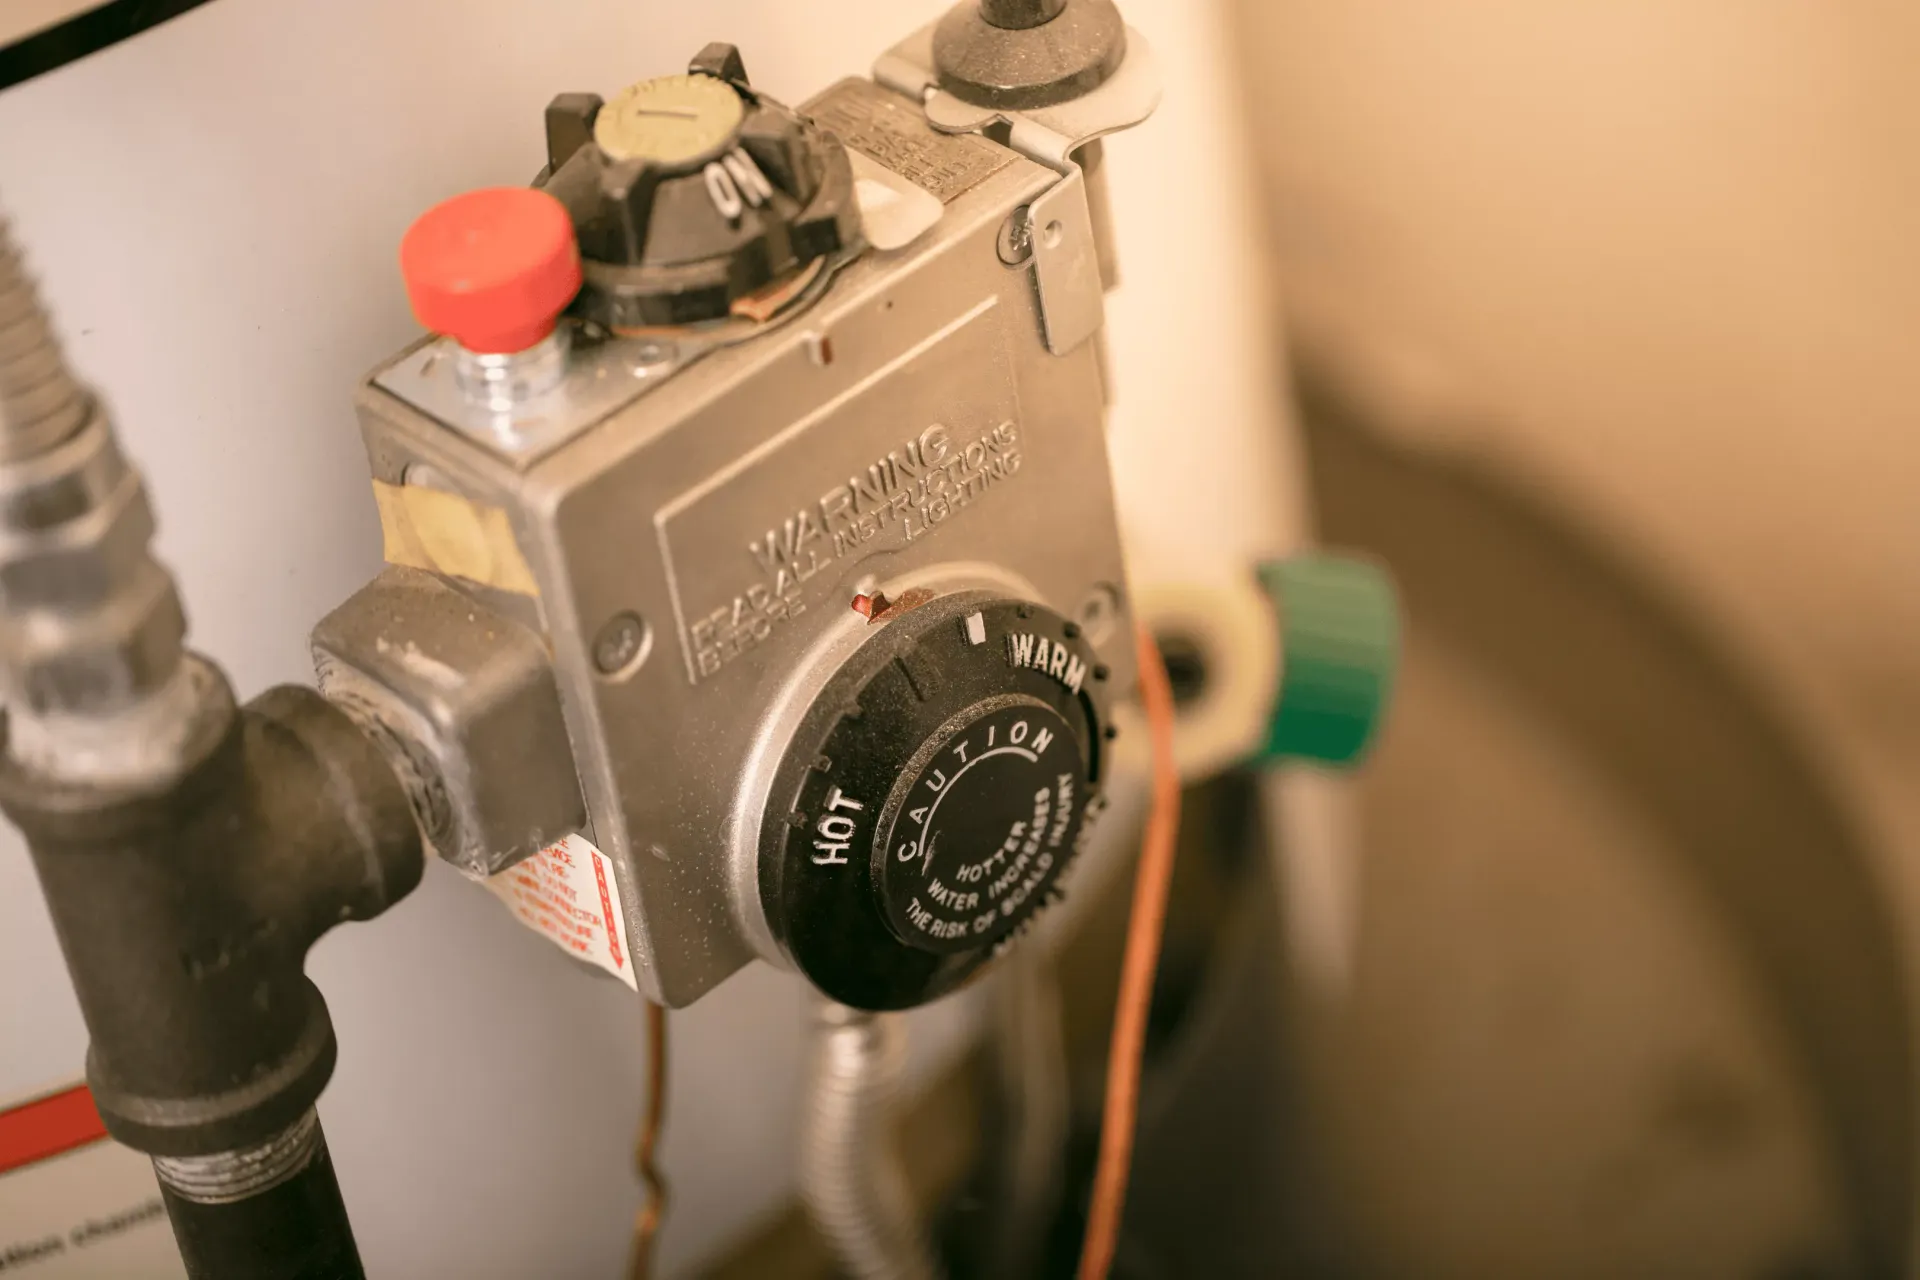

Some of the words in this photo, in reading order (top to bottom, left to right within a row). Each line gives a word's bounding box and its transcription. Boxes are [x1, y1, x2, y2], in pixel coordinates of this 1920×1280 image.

[704, 147, 773, 218] ON
[750, 422, 950, 576] WARNING
[776, 550, 832, 600] ALL
[831, 419, 1018, 558] INSTRUCTIONS
[902, 448, 1023, 541] LIGHTING
[1008, 633, 1088, 694] WARM
[812, 785, 864, 866] HOT
[897, 720, 1053, 863] CAUTION
[905, 897, 931, 931] THE
[930, 912, 969, 938] RISK
[973, 909, 998, 934] OF
[1001, 853, 1054, 916] SCALD
[1050, 772, 1075, 847] INJURY
[927, 877, 980, 912] WATER
[988, 786, 1051, 899] INCREASES
[957, 820, 1028, 883] HOTTER
